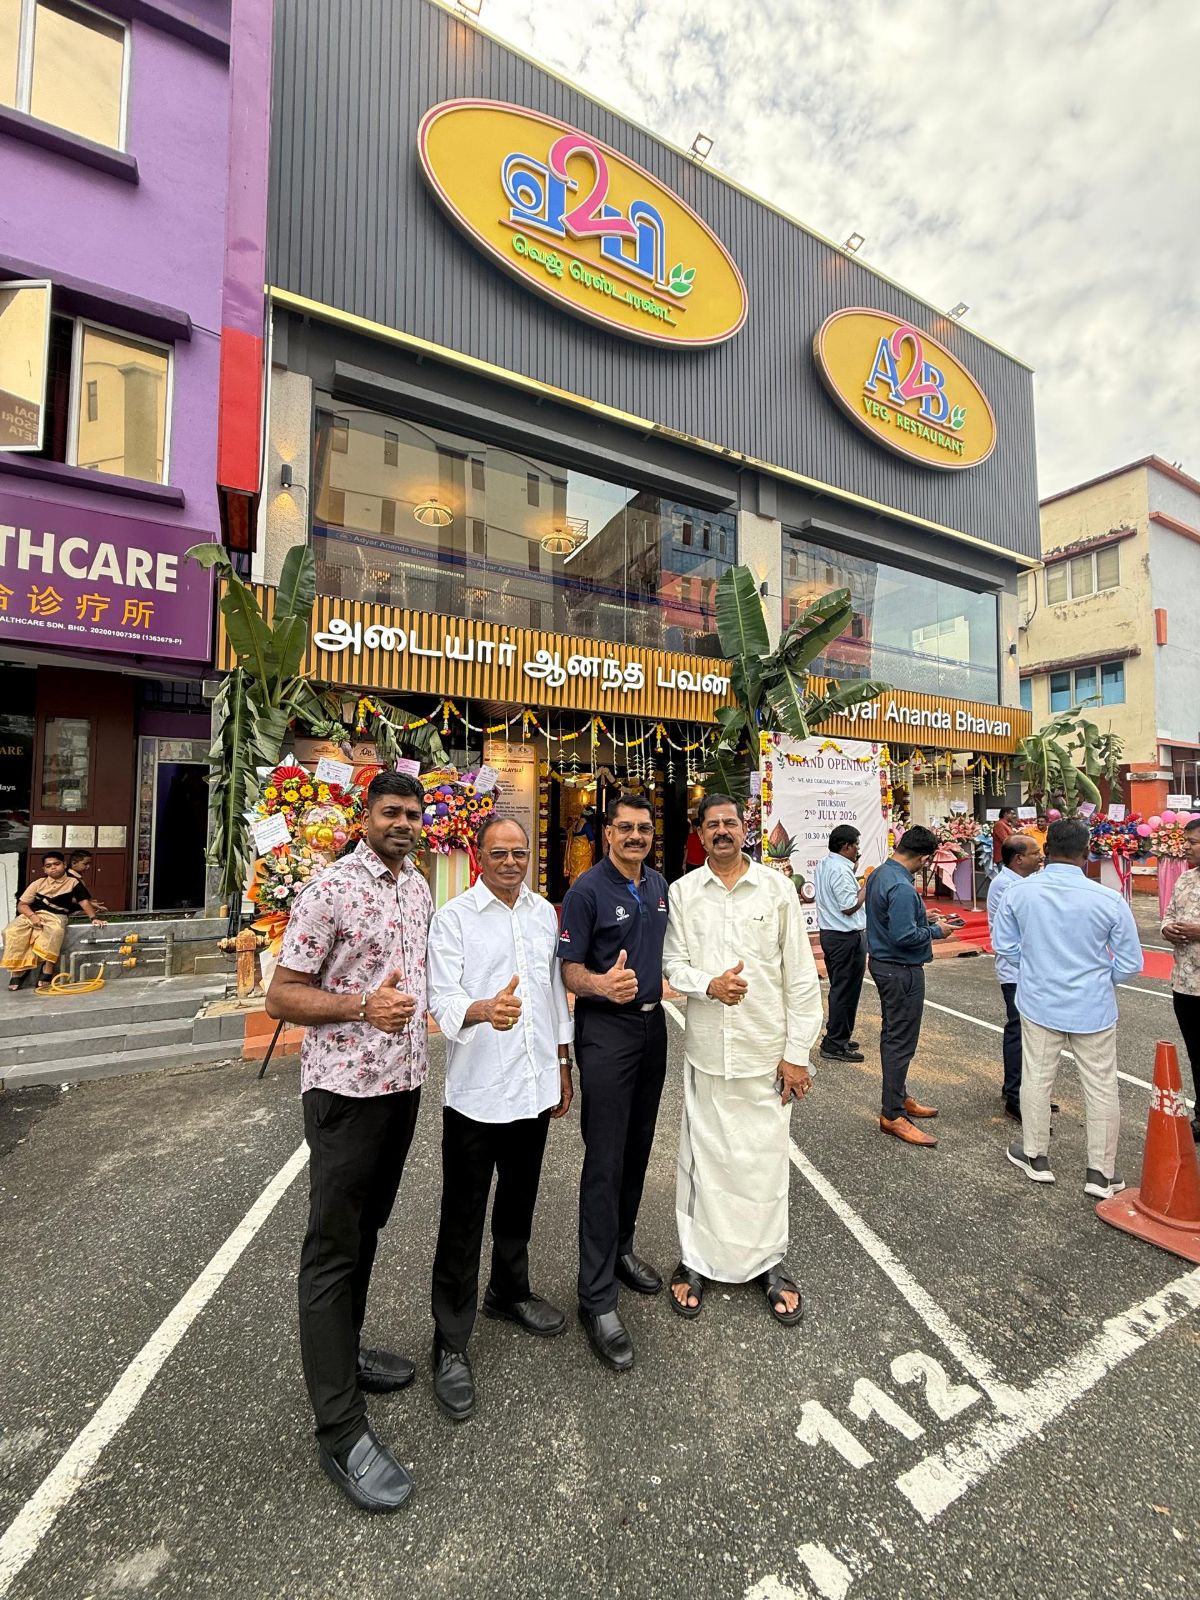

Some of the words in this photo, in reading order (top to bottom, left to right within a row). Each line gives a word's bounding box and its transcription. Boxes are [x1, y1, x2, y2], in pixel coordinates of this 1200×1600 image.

[865, 326, 950, 424] A2B
[896, 413, 966, 456] RESTAURANT
[354, 535, 378, 548] Adyar
[380, 541, 409, 554] Ananda
[46, 621, 66, 630] SDN.
[67, 624, 88, 633] BHD.
[313, 618, 518, 667] அடையார்
[523, 649, 645, 693] ஆனந்த
[884, 700, 951, 729] Ananda
[956, 710, 1011, 737] Bhavan
[827, 757, 870, 772] OPENING
[817, 800, 847, 808] THURSDAY
[818, 810, 838, 820] JULY
[840, 810, 857, 821] 2026
[795, 1350, 982, 1470] 112
